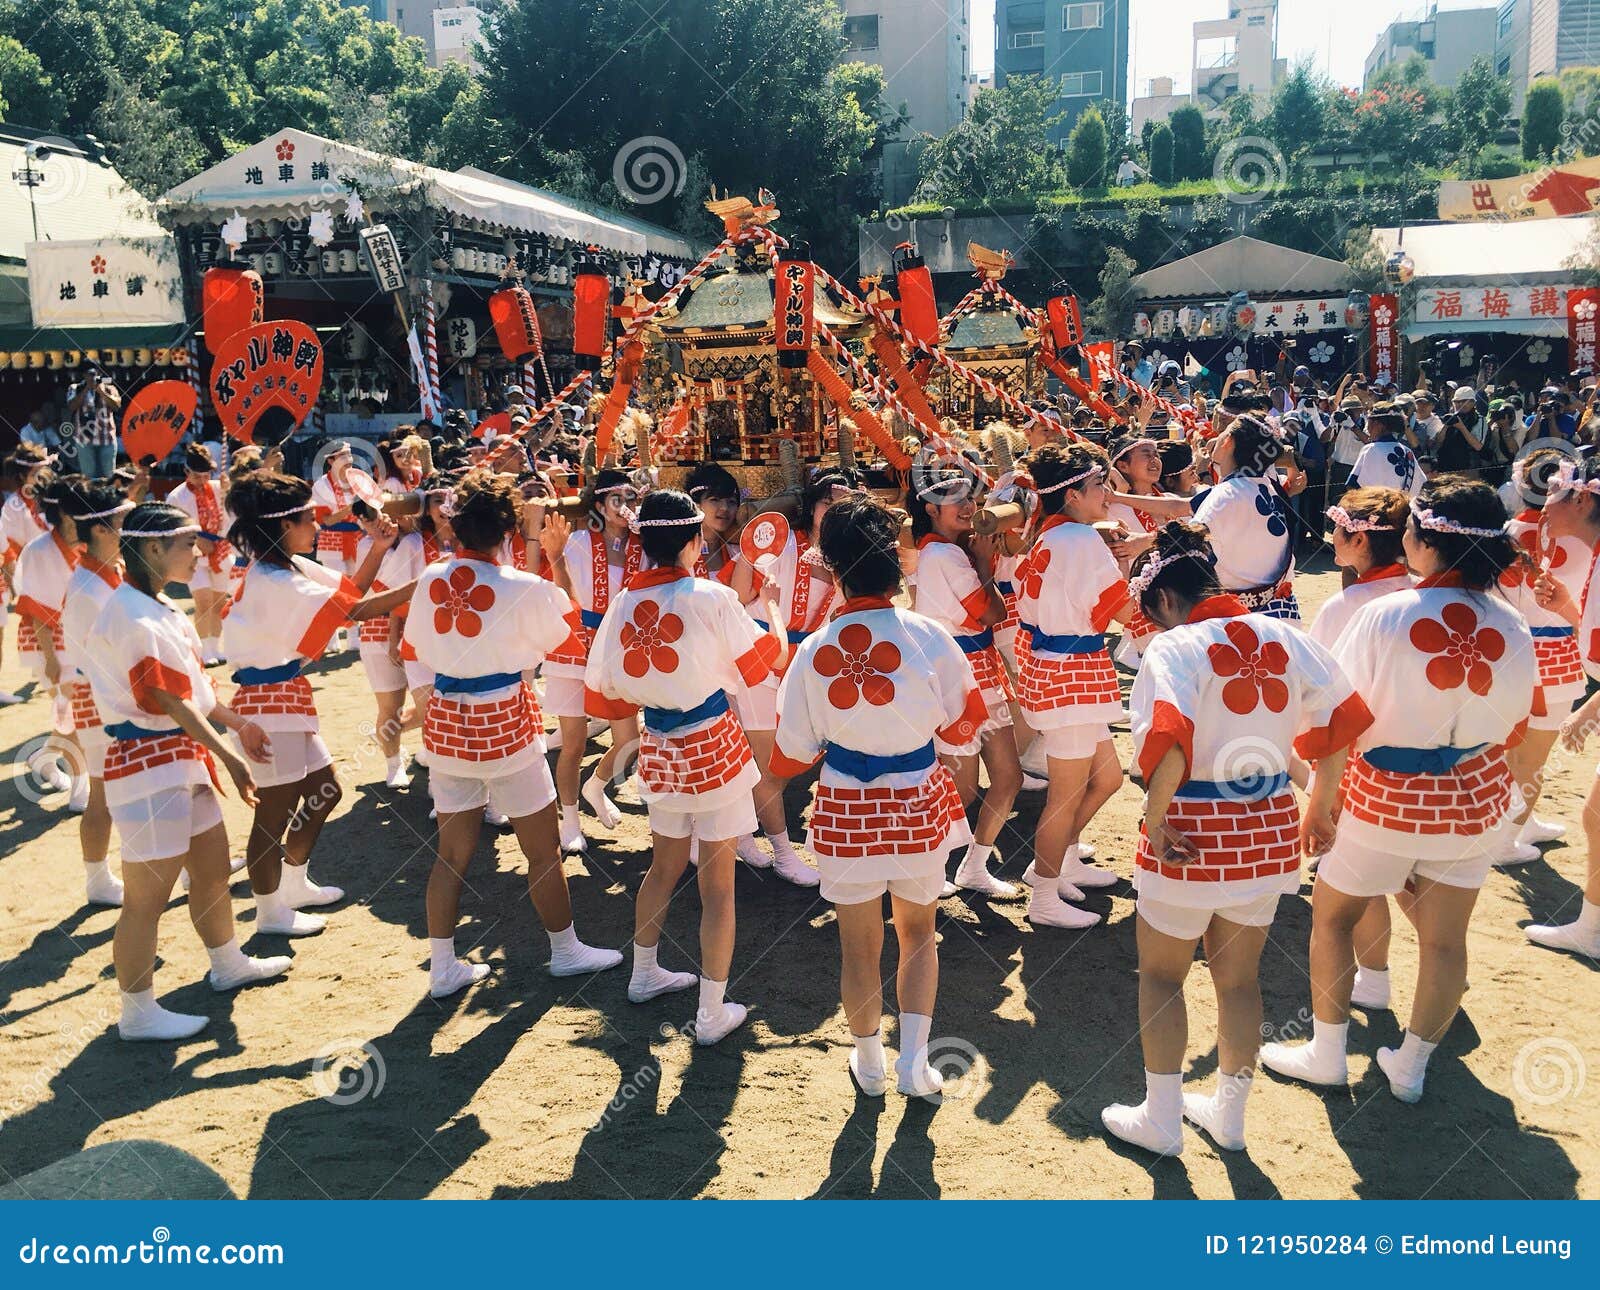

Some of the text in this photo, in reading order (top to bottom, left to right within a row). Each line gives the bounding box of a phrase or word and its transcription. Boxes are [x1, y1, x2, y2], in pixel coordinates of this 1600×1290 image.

[244, 162, 330, 186] 地車講
[1472, 183, 1498, 211] 出
[59, 276, 147, 301] 地車講
[1430, 287, 1561, 320] 福梅講
[1264, 310, 1338, 328] 天神講
[451, 319, 470, 356] 地車
[593, 542, 608, 609] てんじんばし
[794, 542, 810, 616] てじんばし
